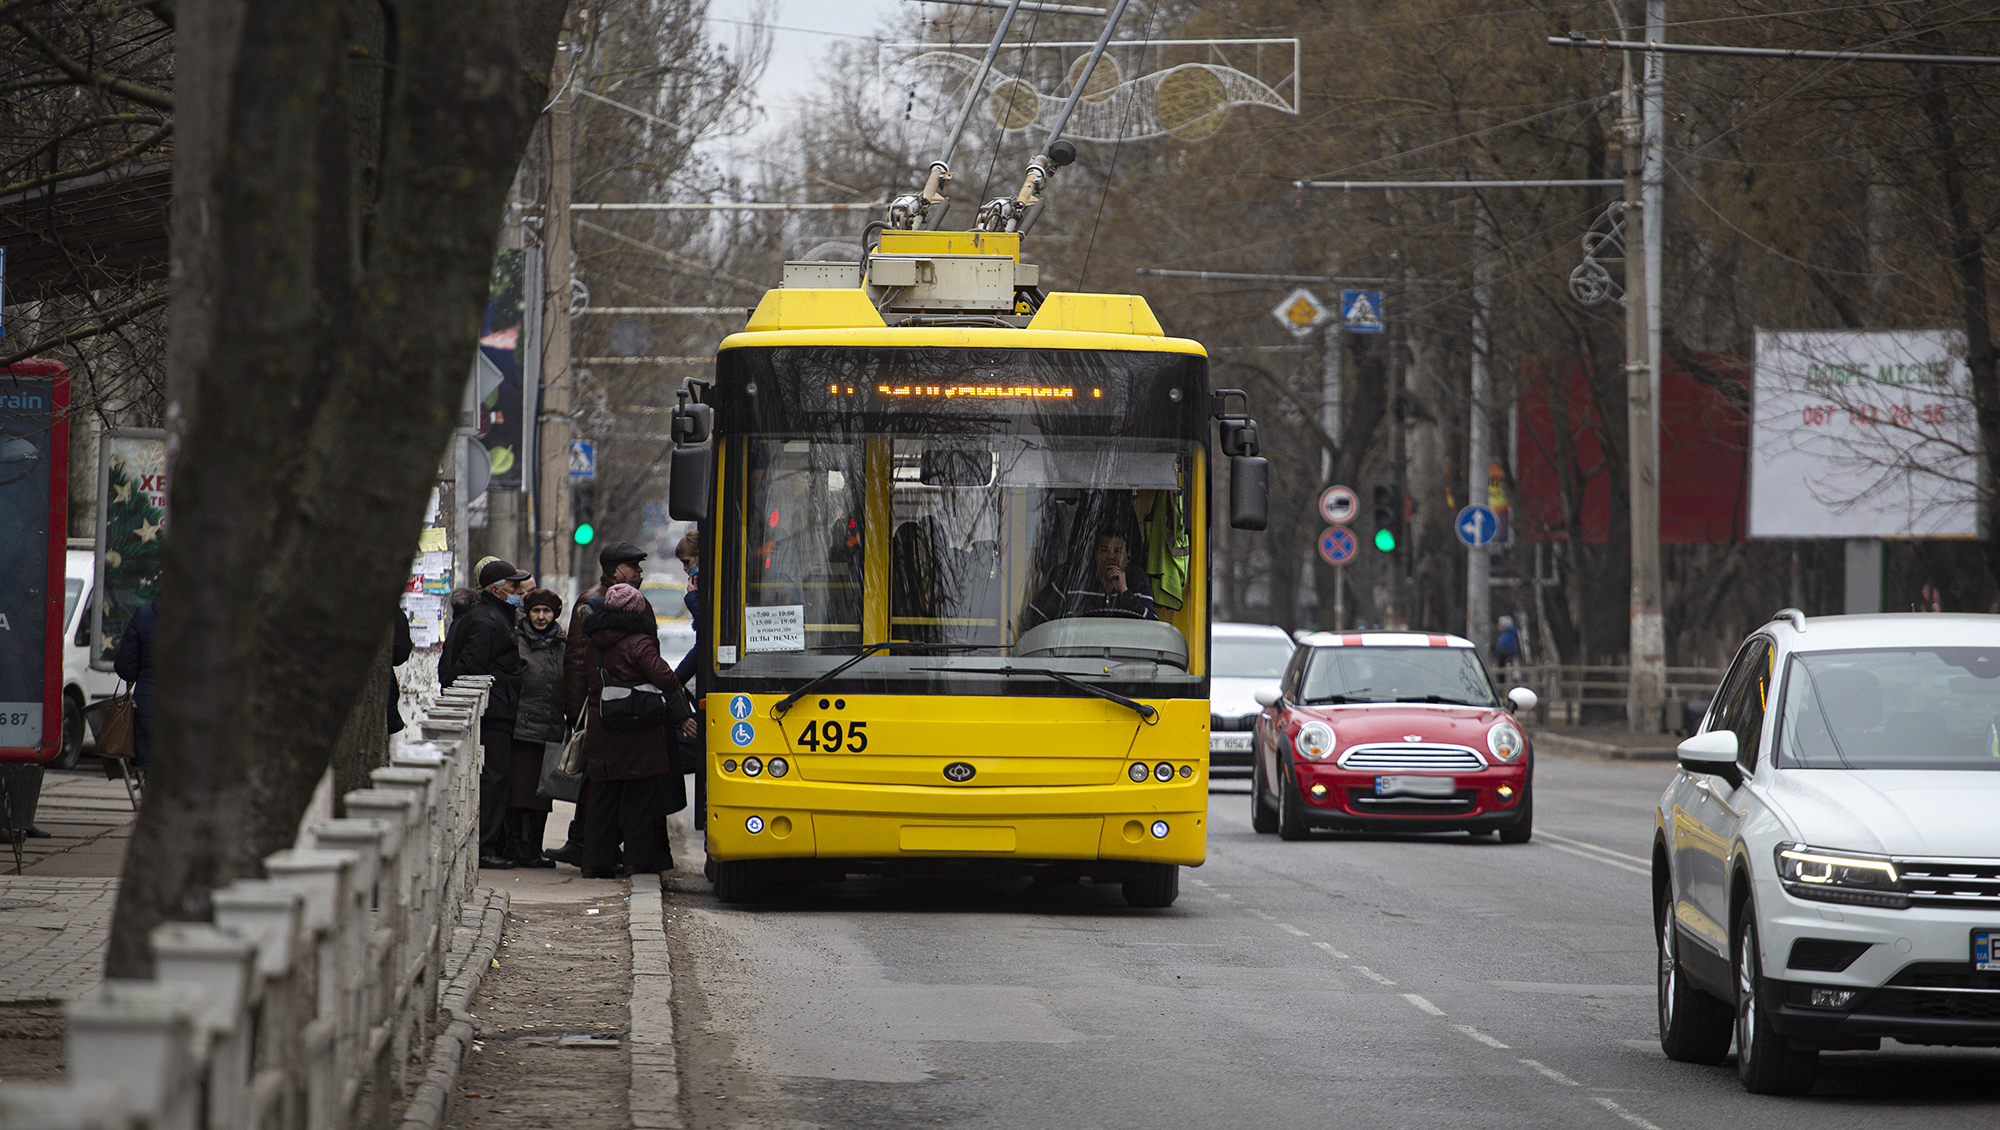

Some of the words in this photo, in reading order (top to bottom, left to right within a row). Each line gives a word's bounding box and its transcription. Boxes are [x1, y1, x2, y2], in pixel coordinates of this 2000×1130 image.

[1803, 404, 1836, 427] 067
[10, 713, 28, 726] 87
[798, 720, 868, 753] 495
[1977, 952, 1988, 960] UA
